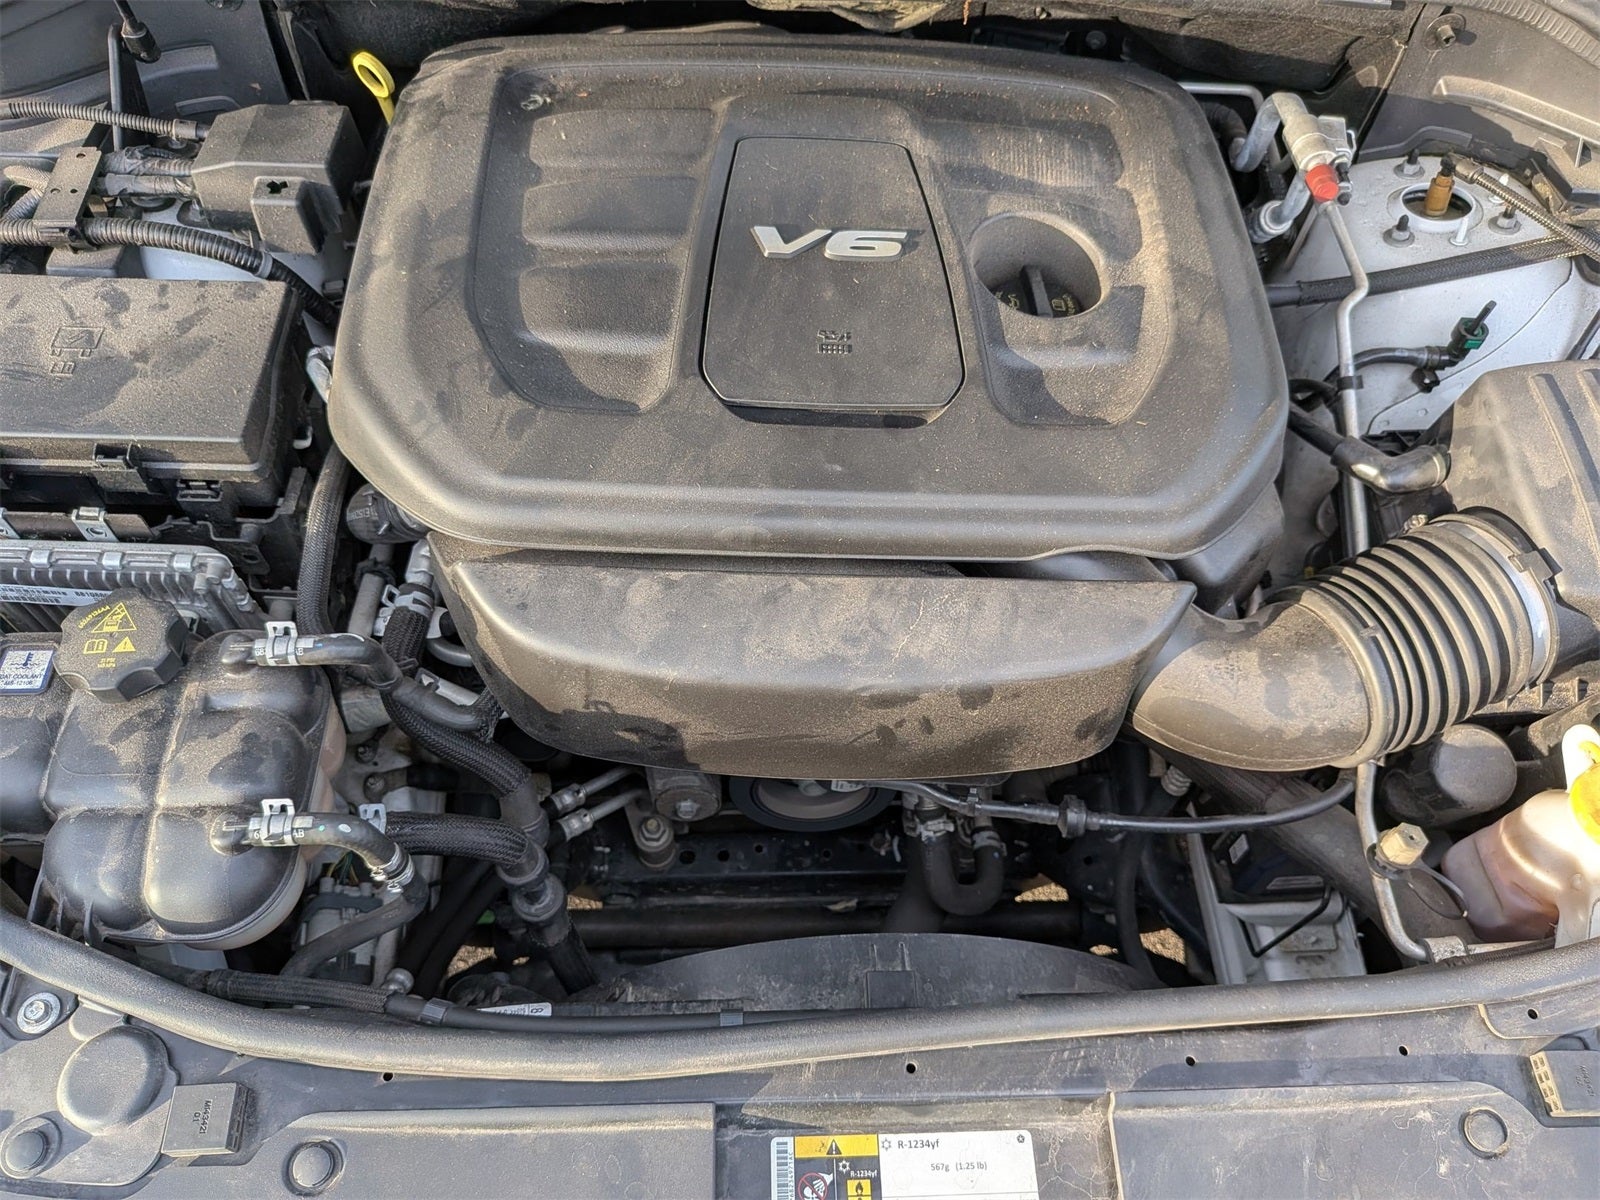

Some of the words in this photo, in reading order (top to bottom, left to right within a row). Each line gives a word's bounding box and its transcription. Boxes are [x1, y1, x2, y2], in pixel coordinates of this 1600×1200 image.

[751, 225, 908, 262] V6
[897, 1138, 940, 1150] R-1234yf
[930, 1163, 950, 1172] 567g
[955, 1162, 975, 1172] (1.25
[976, 1161, 988, 1171] lb)
[850, 1169, 878, 1179] R-1234yf
